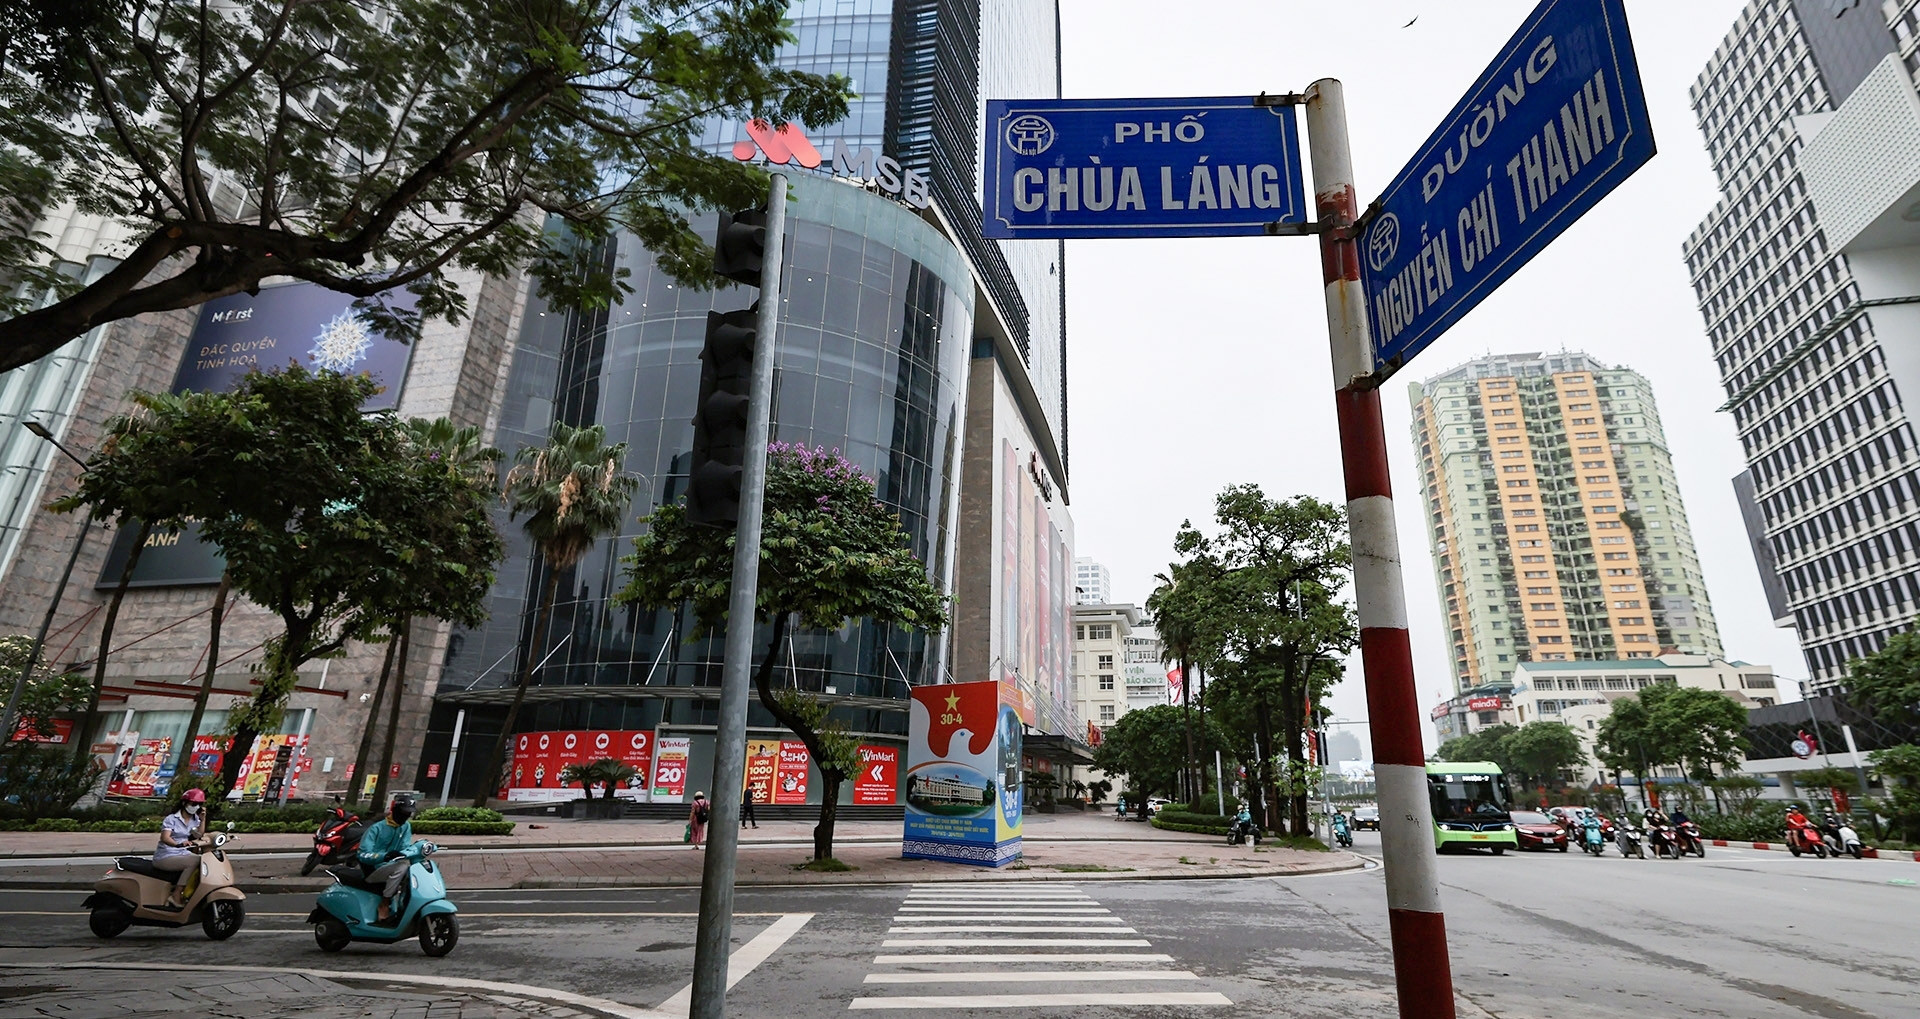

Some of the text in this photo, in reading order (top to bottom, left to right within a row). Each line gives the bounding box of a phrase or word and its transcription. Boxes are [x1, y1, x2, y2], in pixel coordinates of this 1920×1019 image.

[1421, 34, 1558, 204] ĐƯỜNG
[1115, 111, 1208, 143] PHỐ
[832, 138, 929, 209] MSB
[1013, 155, 1281, 212] CHÙA LÁNG
[1375, 67, 1615, 348] NGUYỄN CHÍ THANH
[200, 344, 228, 357] ĐẶC
[196, 358, 226, 370] TINH
[1472, 699, 1498, 709] mindX
[940, 713, 963, 725] 30-4
[659, 740, 690, 749] WinMart
[860, 749, 894, 762] WinMart
[749, 766, 773, 775] 1000
